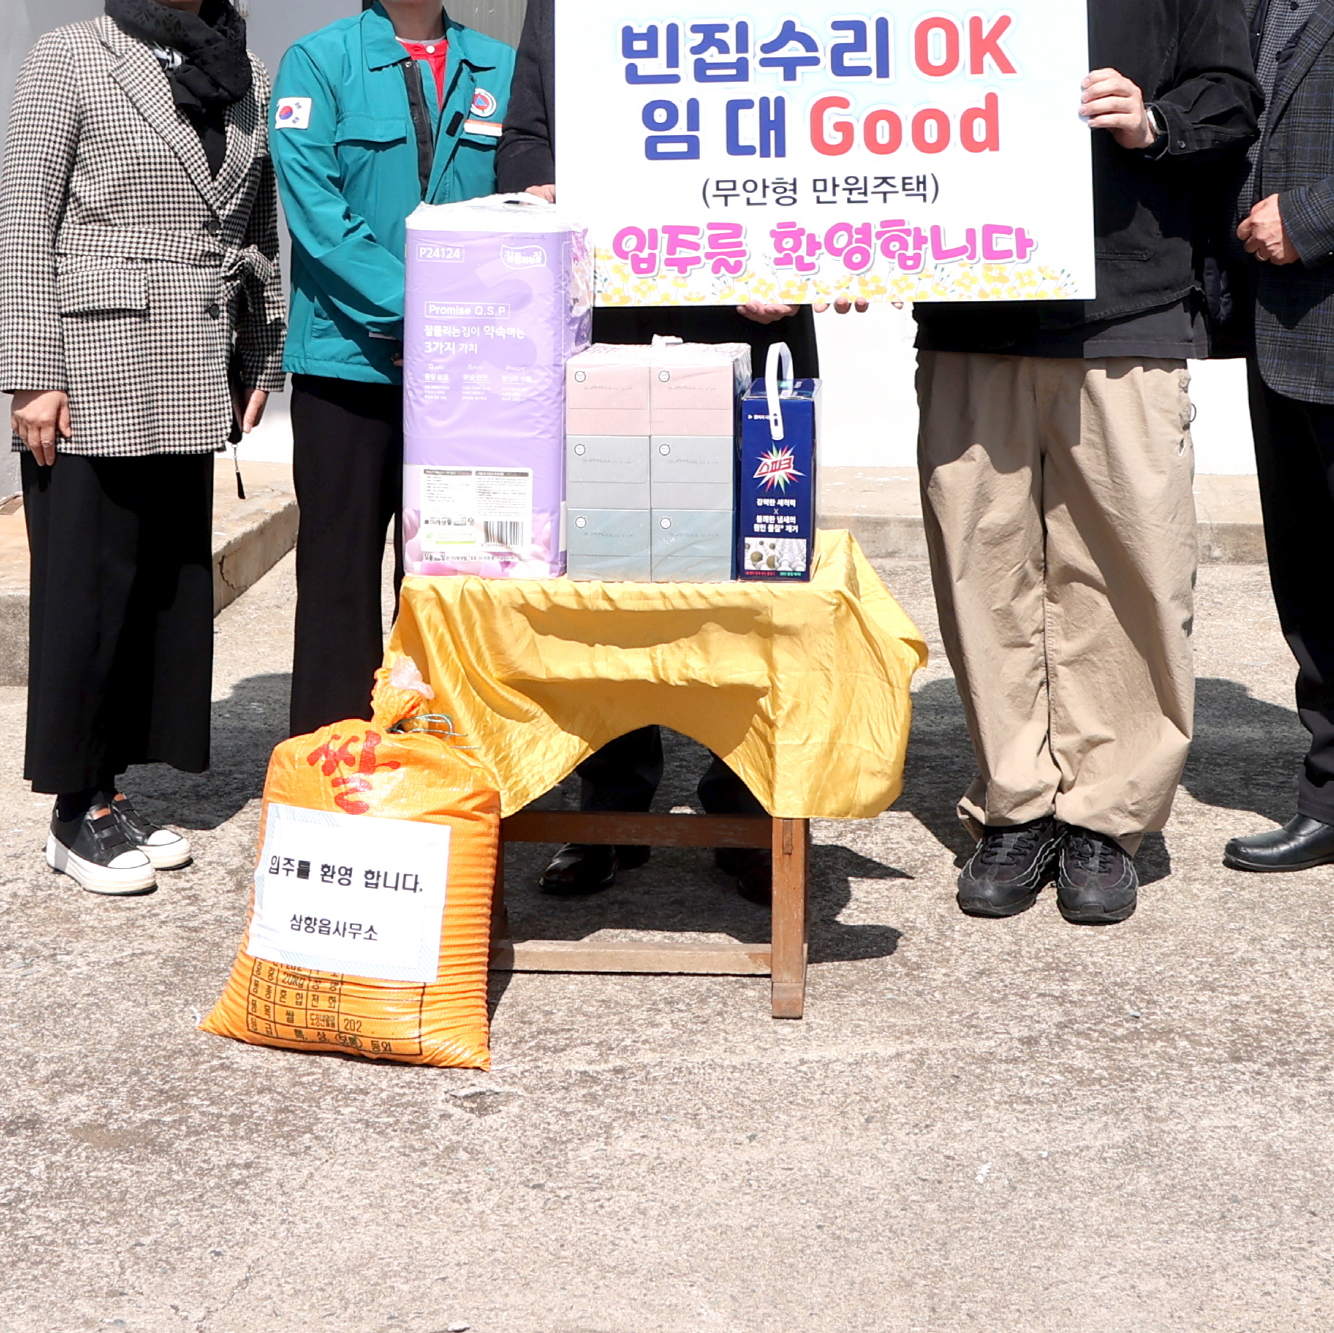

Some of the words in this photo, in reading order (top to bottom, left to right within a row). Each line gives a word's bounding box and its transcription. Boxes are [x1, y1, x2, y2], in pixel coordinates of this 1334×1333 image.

[621, 16, 890, 85] 빈집수리
[914, 14, 1017, 77] OK
[809, 92, 1000, 156] Good
[701, 177, 799, 209] (무안형
[812, 173, 940, 205] 만원주택)
[419, 247, 461, 259] P24124
[612, 222, 748, 276] 입주를
[770, 218, 1034, 272] 환영합니다
[428, 304, 472, 315] Promise
[474, 306, 506, 316] Q.S.P
[424, 325, 480, 338] 잘풀리는집이
[483, 325, 526, 339] 약속하는
[424, 341, 455, 355] 3가지
[458, 343, 478, 354] 가치
[756, 457, 792, 477] 스파크
[307, 730, 401, 815] 쌀
[268, 855, 311, 880] 입주를
[320, 863, 353, 886] 환영
[364, 869, 423, 893] 합니다.
[290, 914, 379, 941] 삼향읍사무소
[343, 1018, 362, 1033] 202
